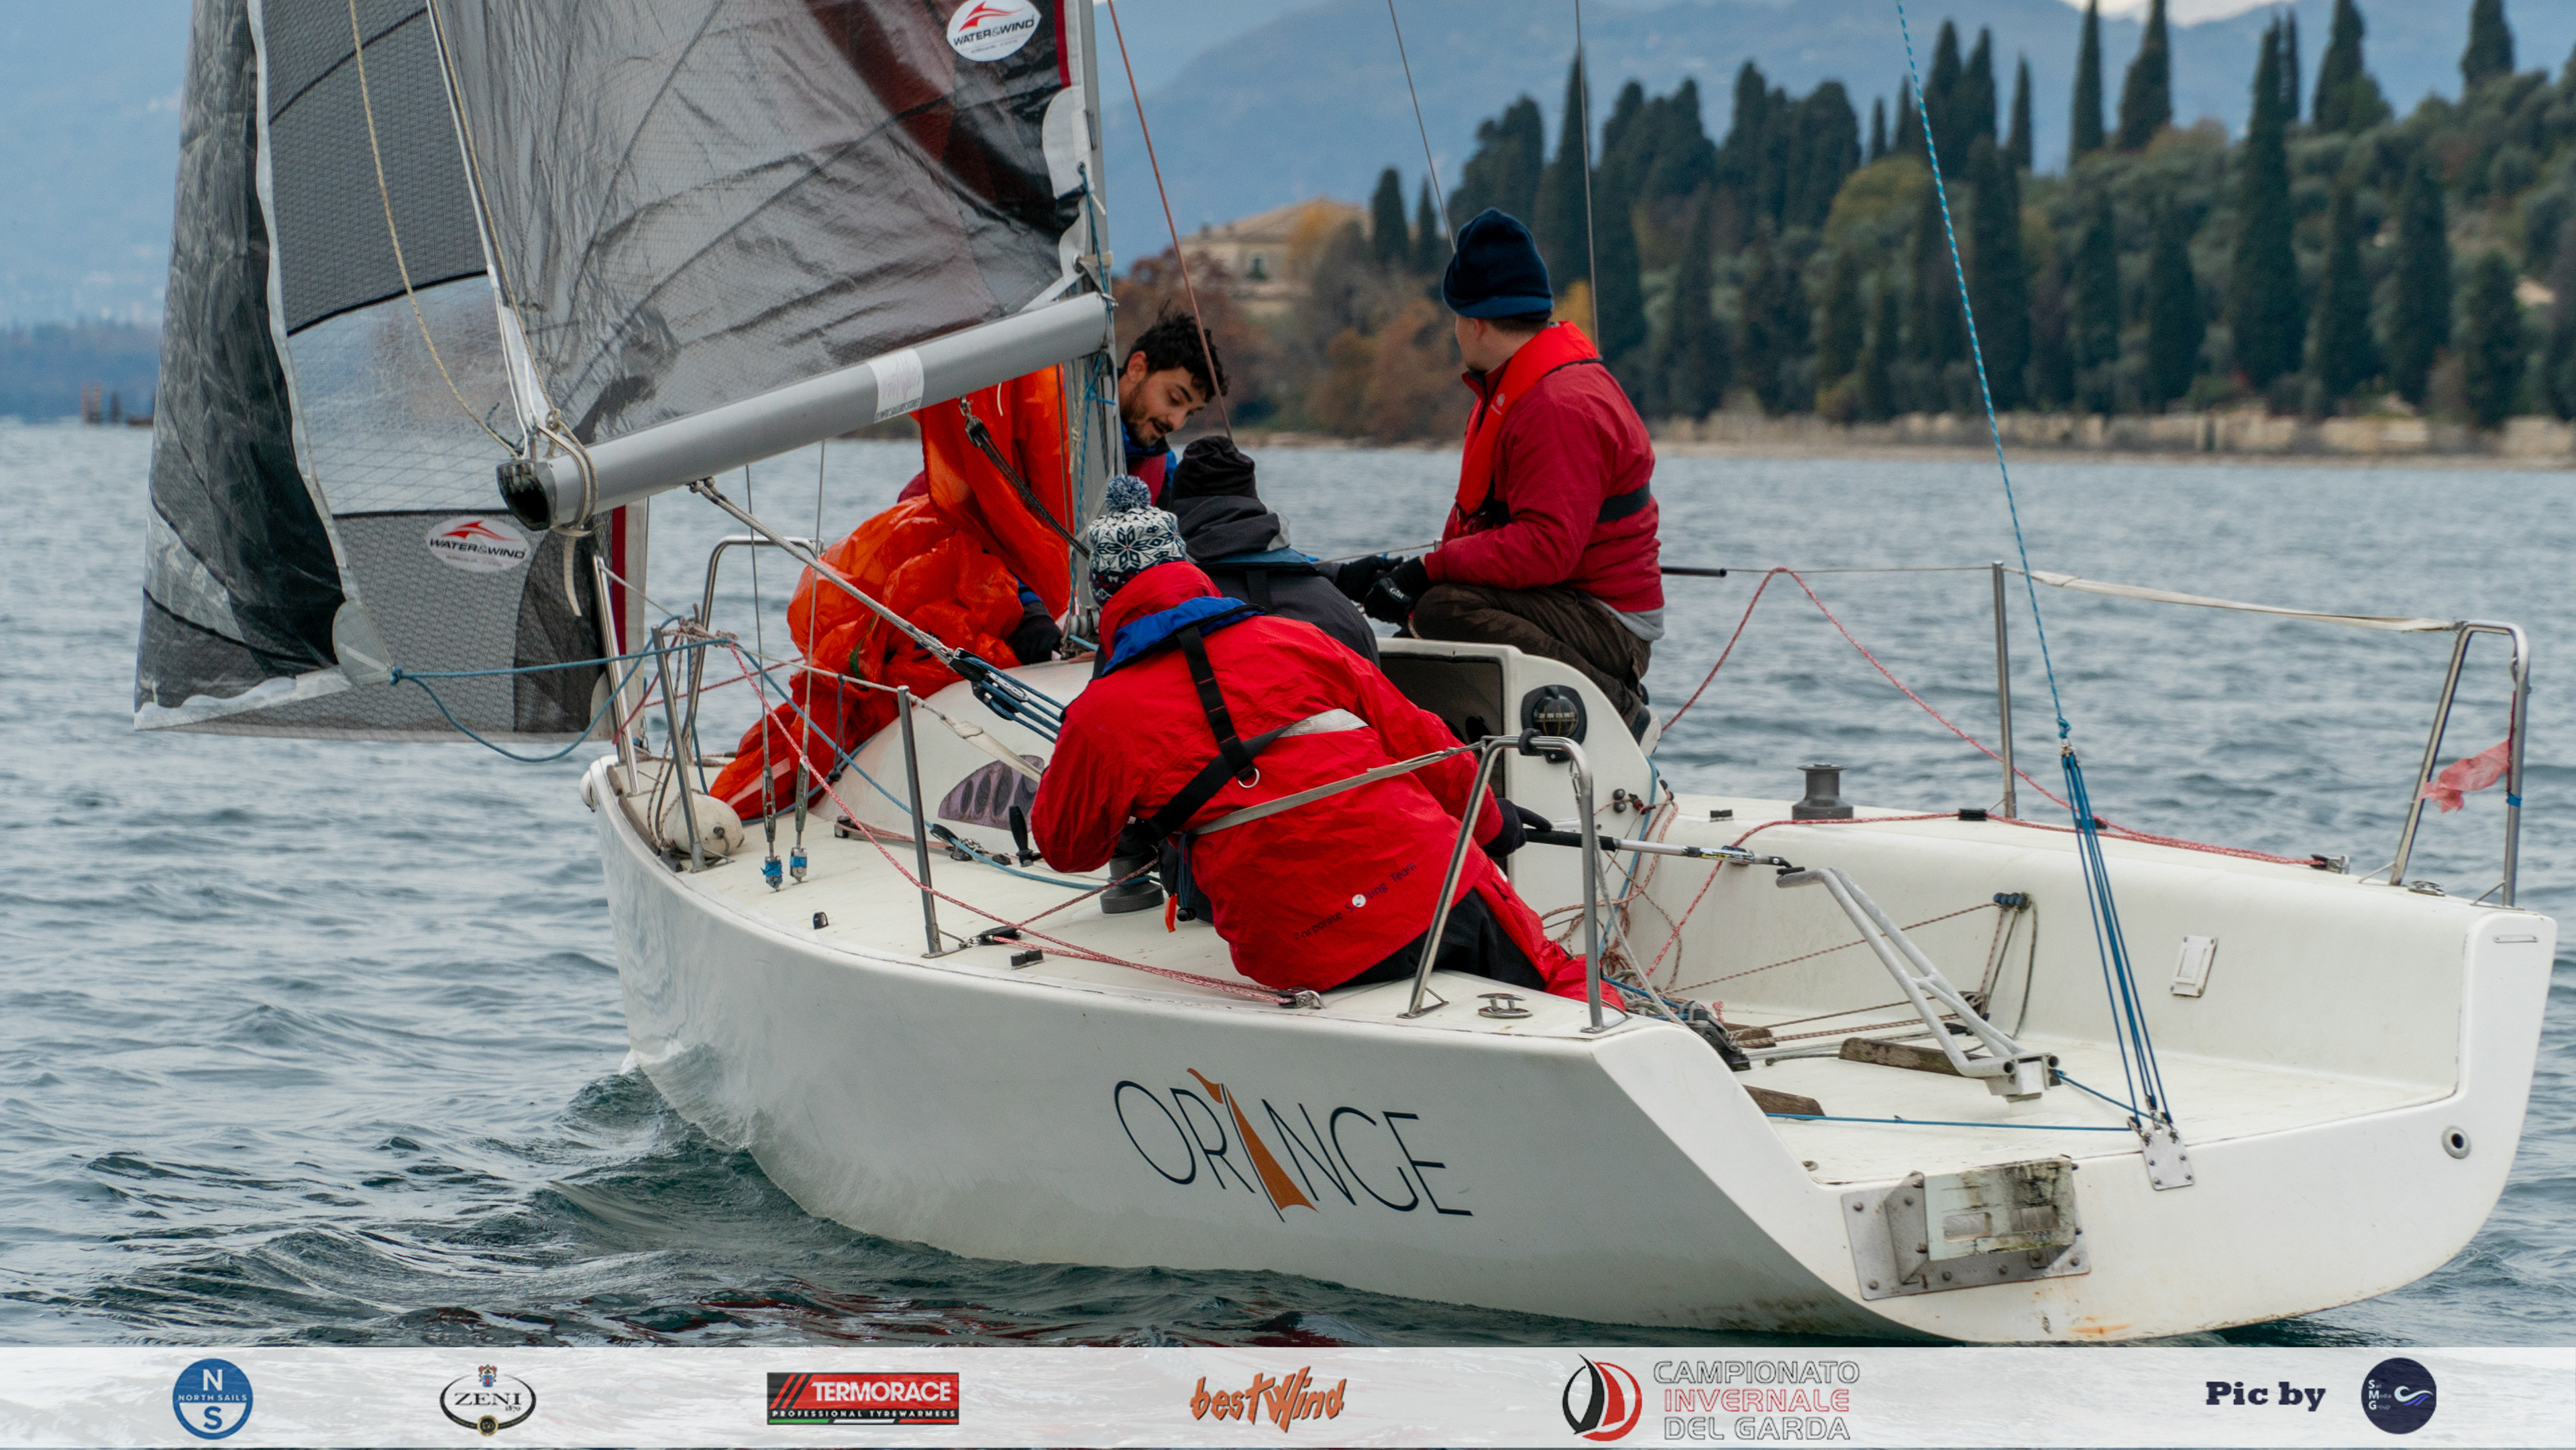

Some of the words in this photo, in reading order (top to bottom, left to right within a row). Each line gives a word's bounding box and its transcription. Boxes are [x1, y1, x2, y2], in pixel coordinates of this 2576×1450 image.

[953, 19, 1035, 46] WATER&WIND
[429, 537, 526, 560] WATER&WIND
[1389, 862, 1417, 882] Team
[1114, 1068, 1474, 1223] ORANGE
